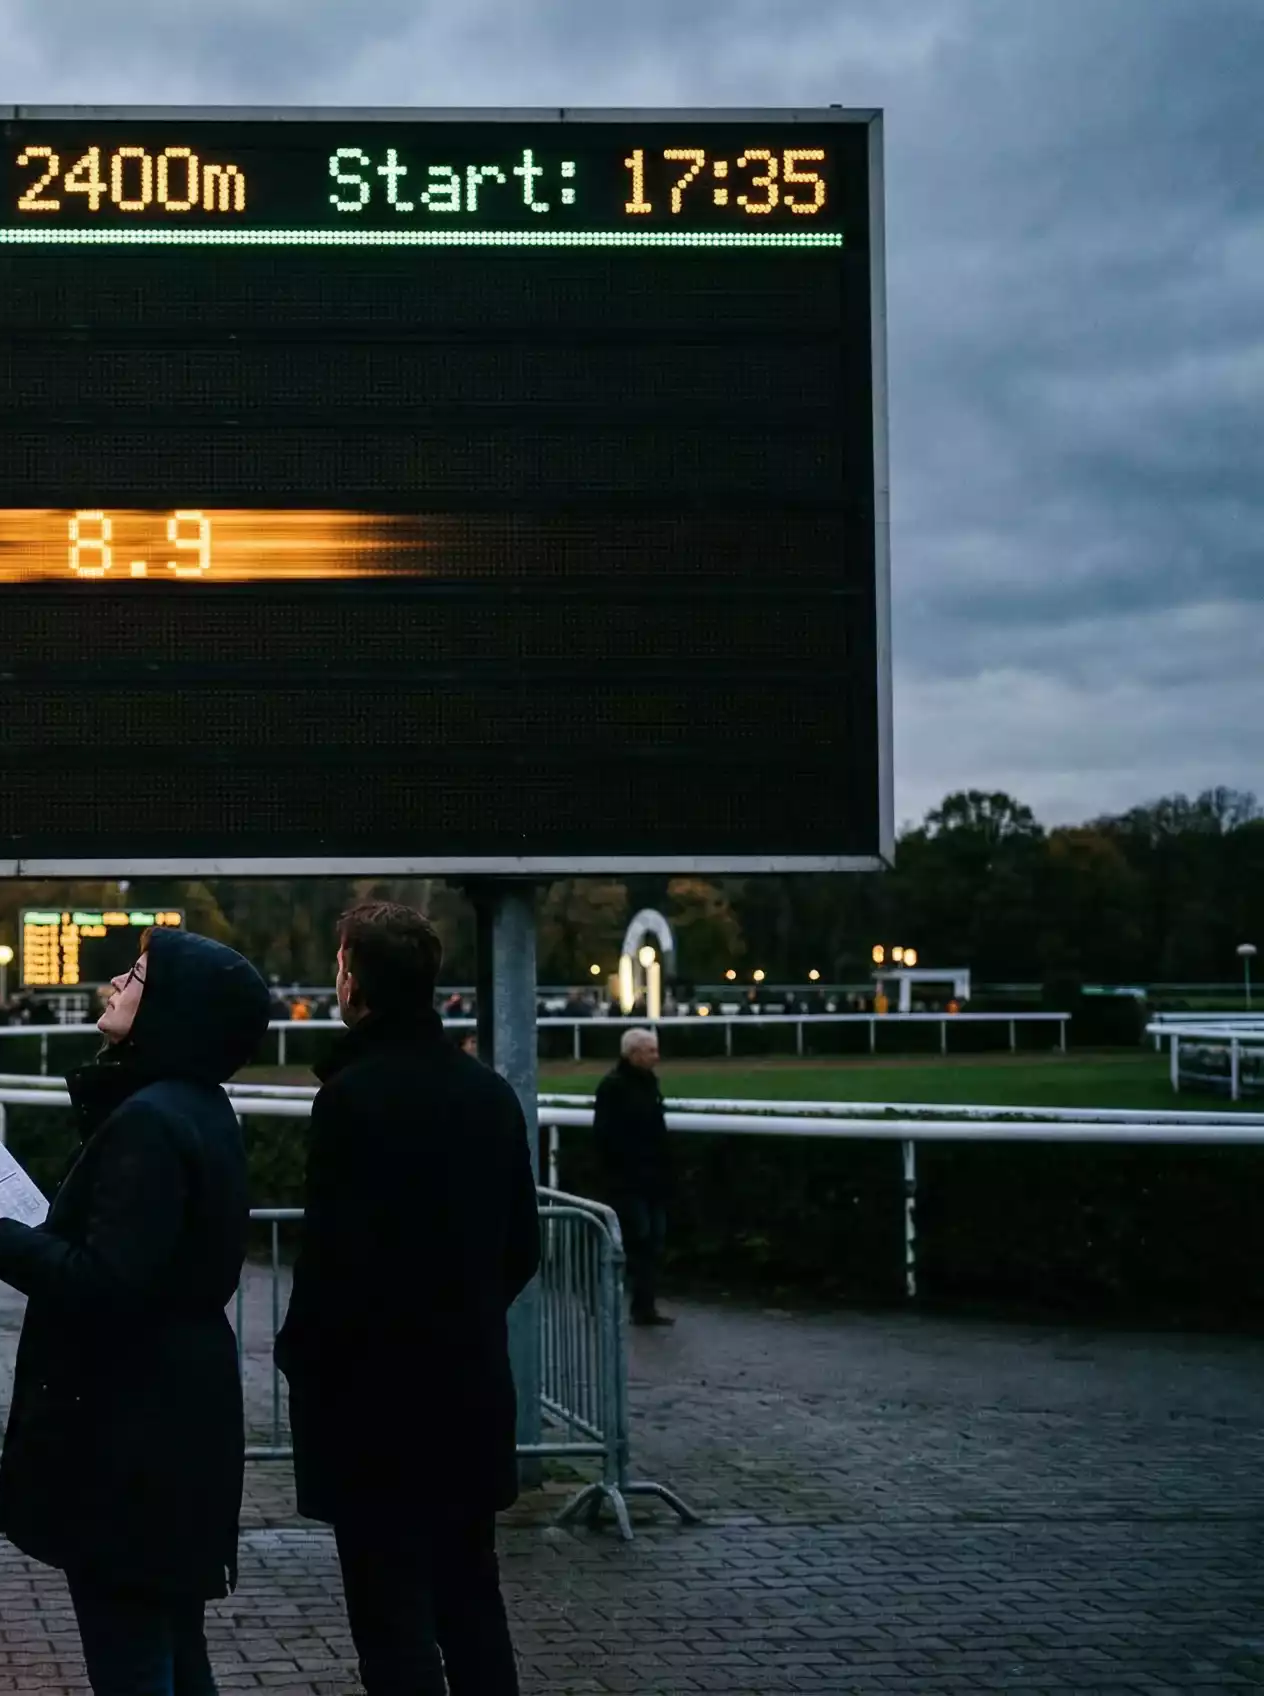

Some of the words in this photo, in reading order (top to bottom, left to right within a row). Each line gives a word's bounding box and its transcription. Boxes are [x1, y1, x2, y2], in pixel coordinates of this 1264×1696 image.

[16, 146, 246, 212] 2400m
[328, 147, 576, 213] Start:
[624, 149, 825, 214] 17:35
[68, 511, 211, 578] 8.9
